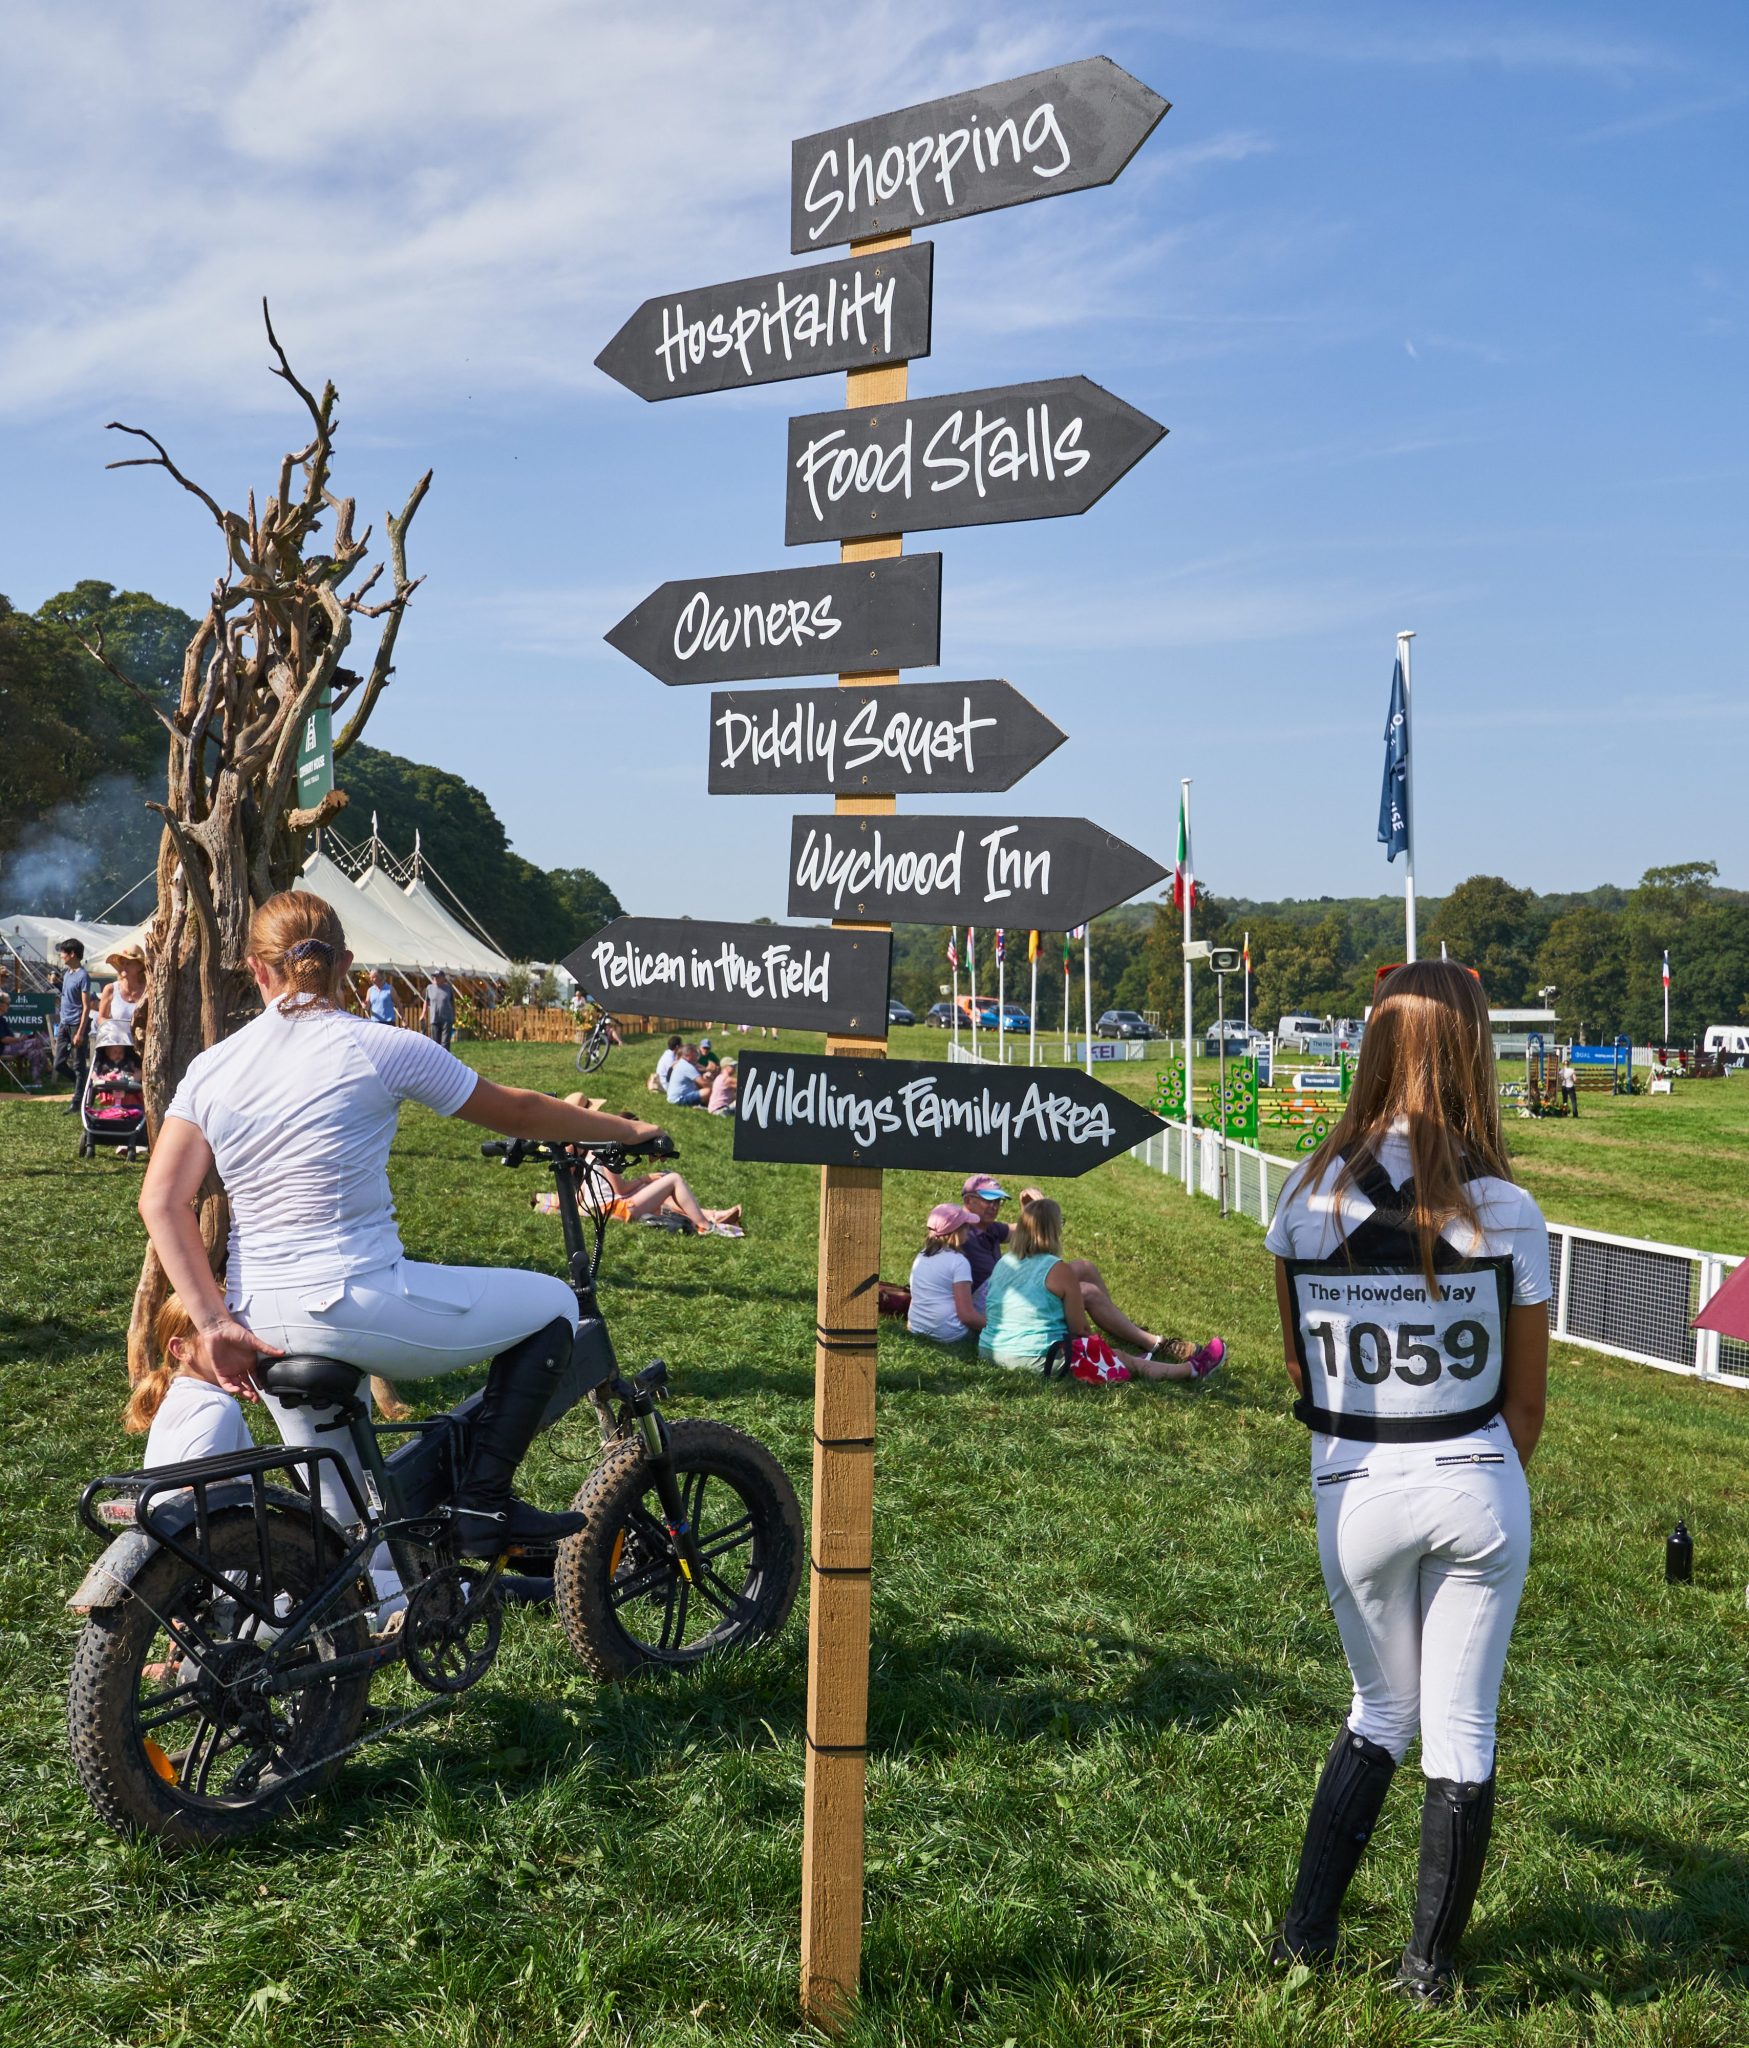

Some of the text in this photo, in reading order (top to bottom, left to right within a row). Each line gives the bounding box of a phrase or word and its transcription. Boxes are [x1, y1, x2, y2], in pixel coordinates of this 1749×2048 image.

[804, 103, 1070, 239] Shopping
[655, 271, 896, 381] Hospitality
[796, 403, 1091, 521] Food Stalls
[673, 591, 842, 660] Owners
[715, 696, 998, 782] Diddly Squat
[796, 824, 1050, 911] Wychood Inn
[591, 940, 831, 1003] Pelican in the Field
[741, 1067, 902, 1147] Wildlings
[896, 1075, 1011, 1156] Family
[1308, 1282, 1341, 1300] The
[1347, 1284, 1427, 1301] Howden
[1308, 1319, 1490, 1386] 1059
